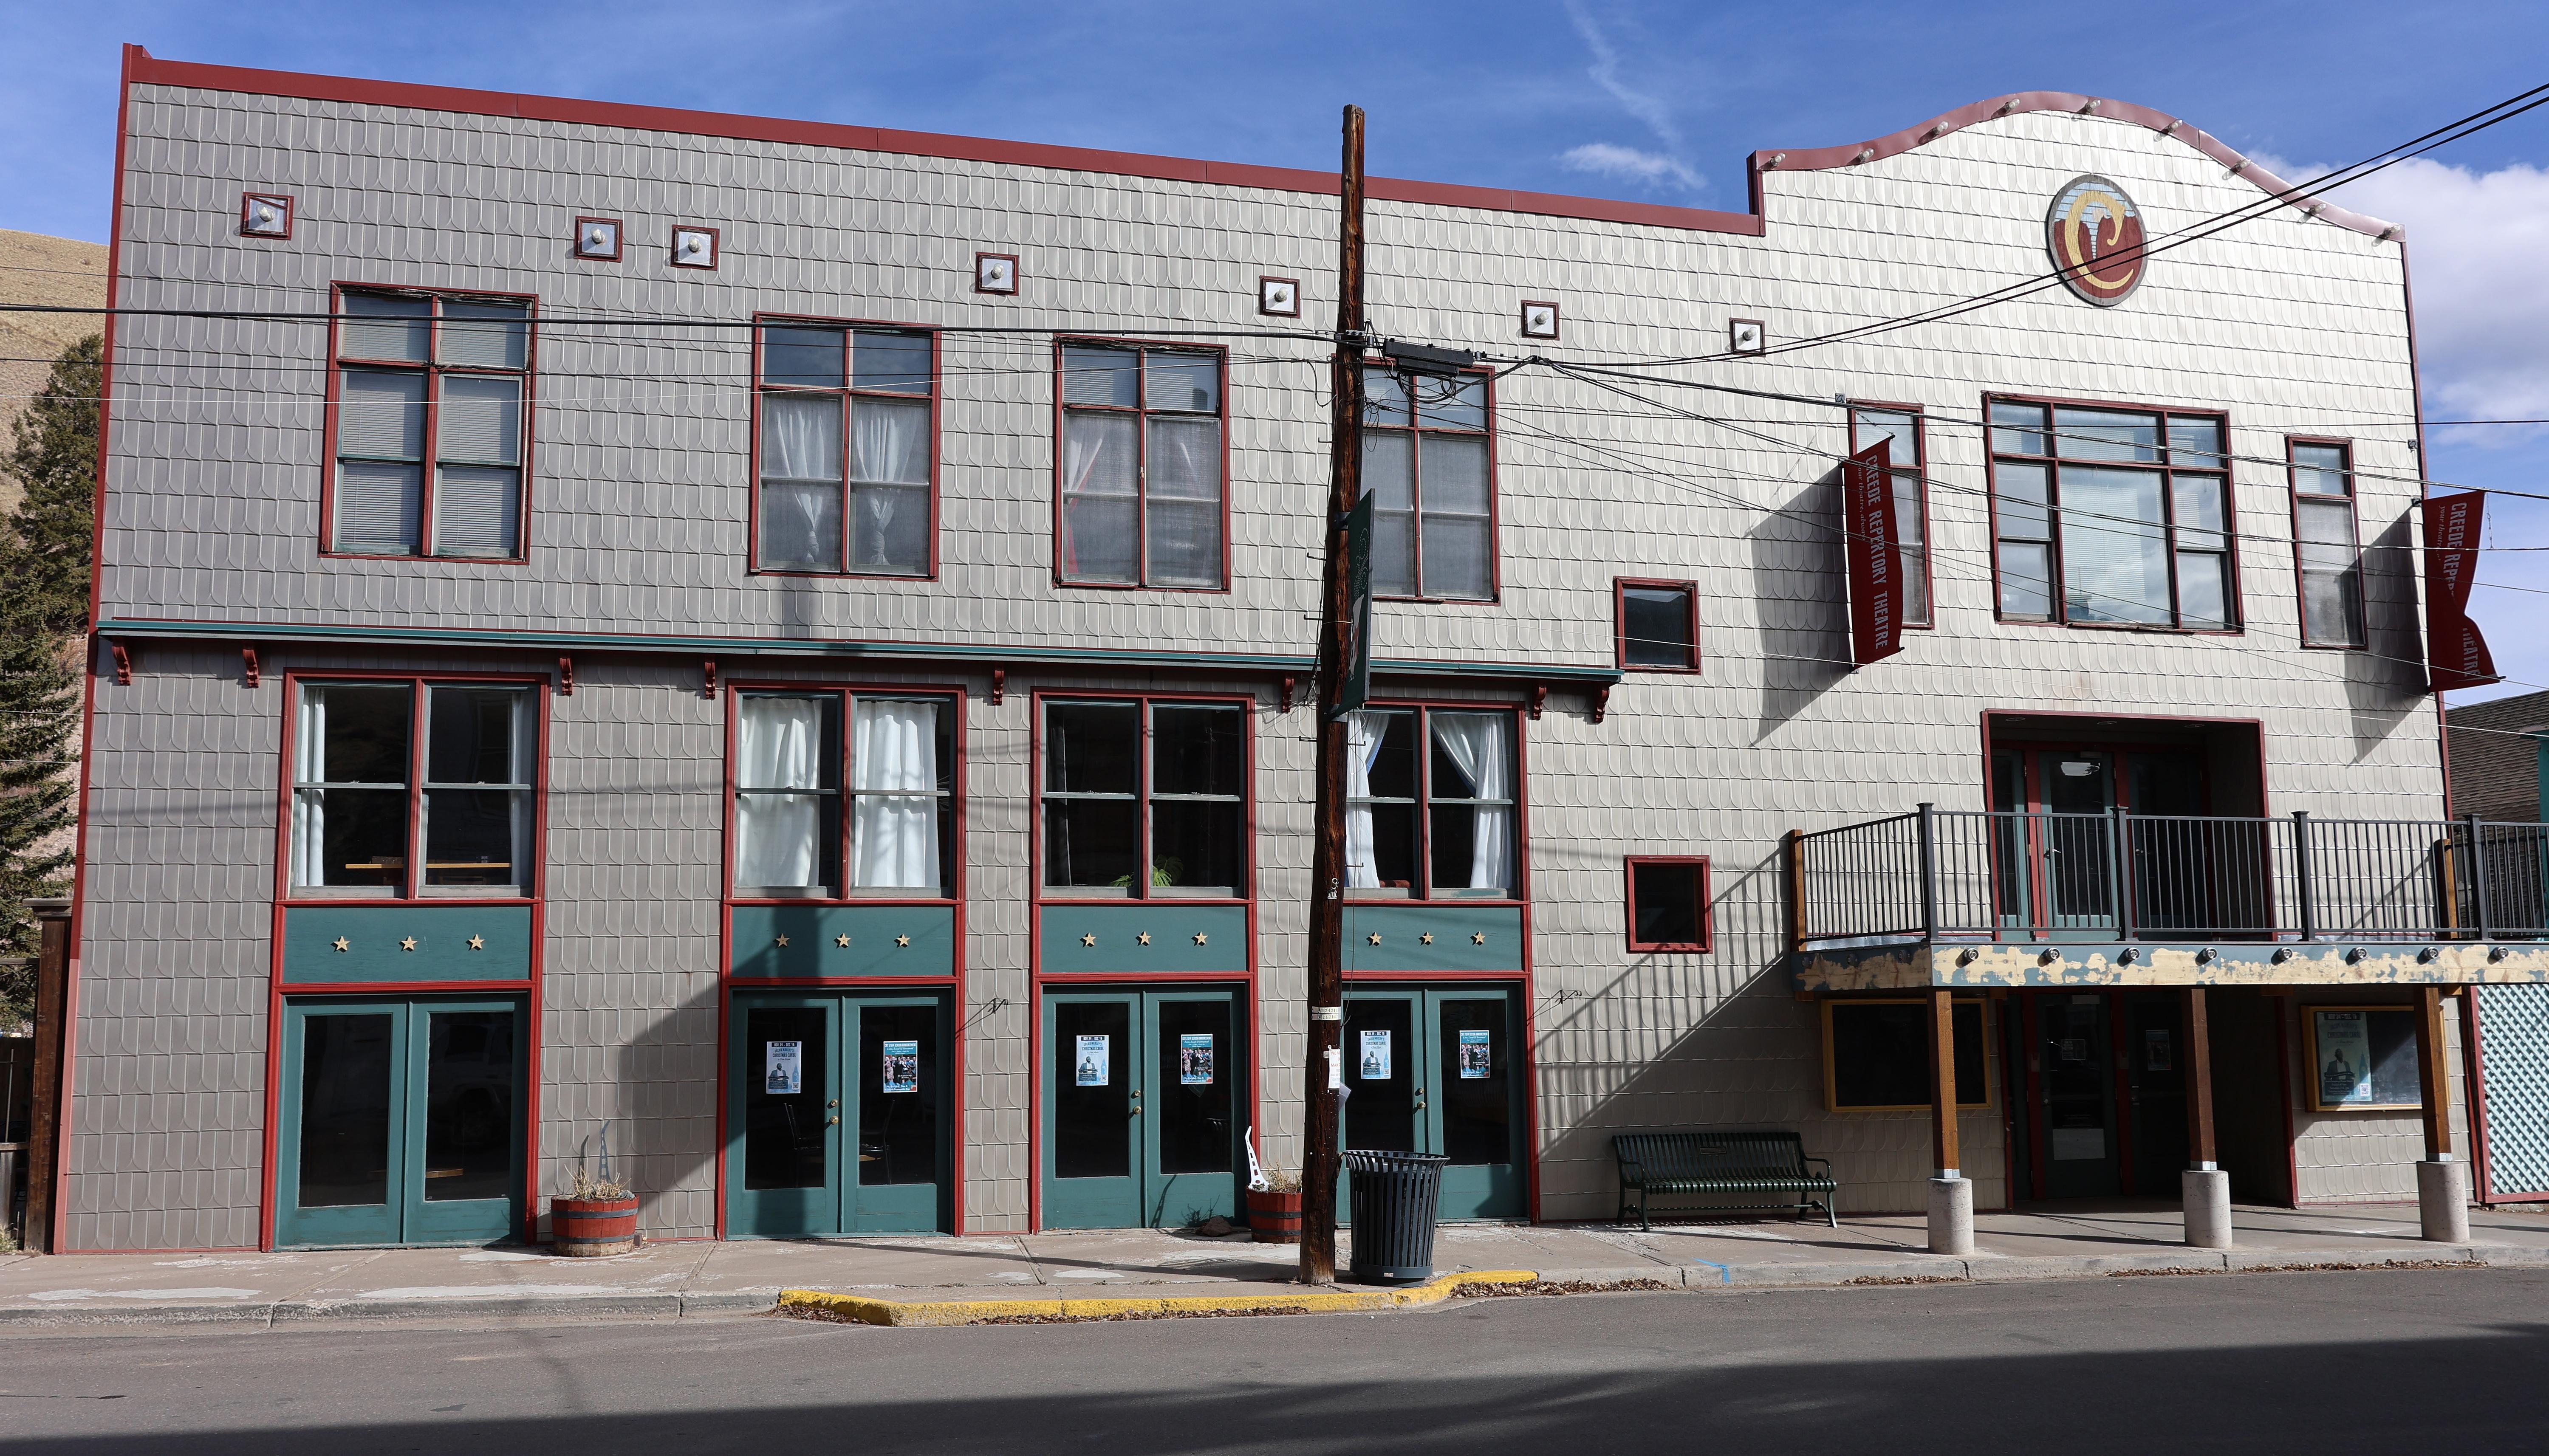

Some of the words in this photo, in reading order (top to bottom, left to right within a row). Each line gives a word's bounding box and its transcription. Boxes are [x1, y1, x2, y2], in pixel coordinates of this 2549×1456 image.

[1865, 454, 1881, 507] CREEDE
[1869, 509, 1887, 585] REPERTORY
[2447, 502, 2467, 548] CREEDE
[1874, 590, 1888, 650] THEATRE
